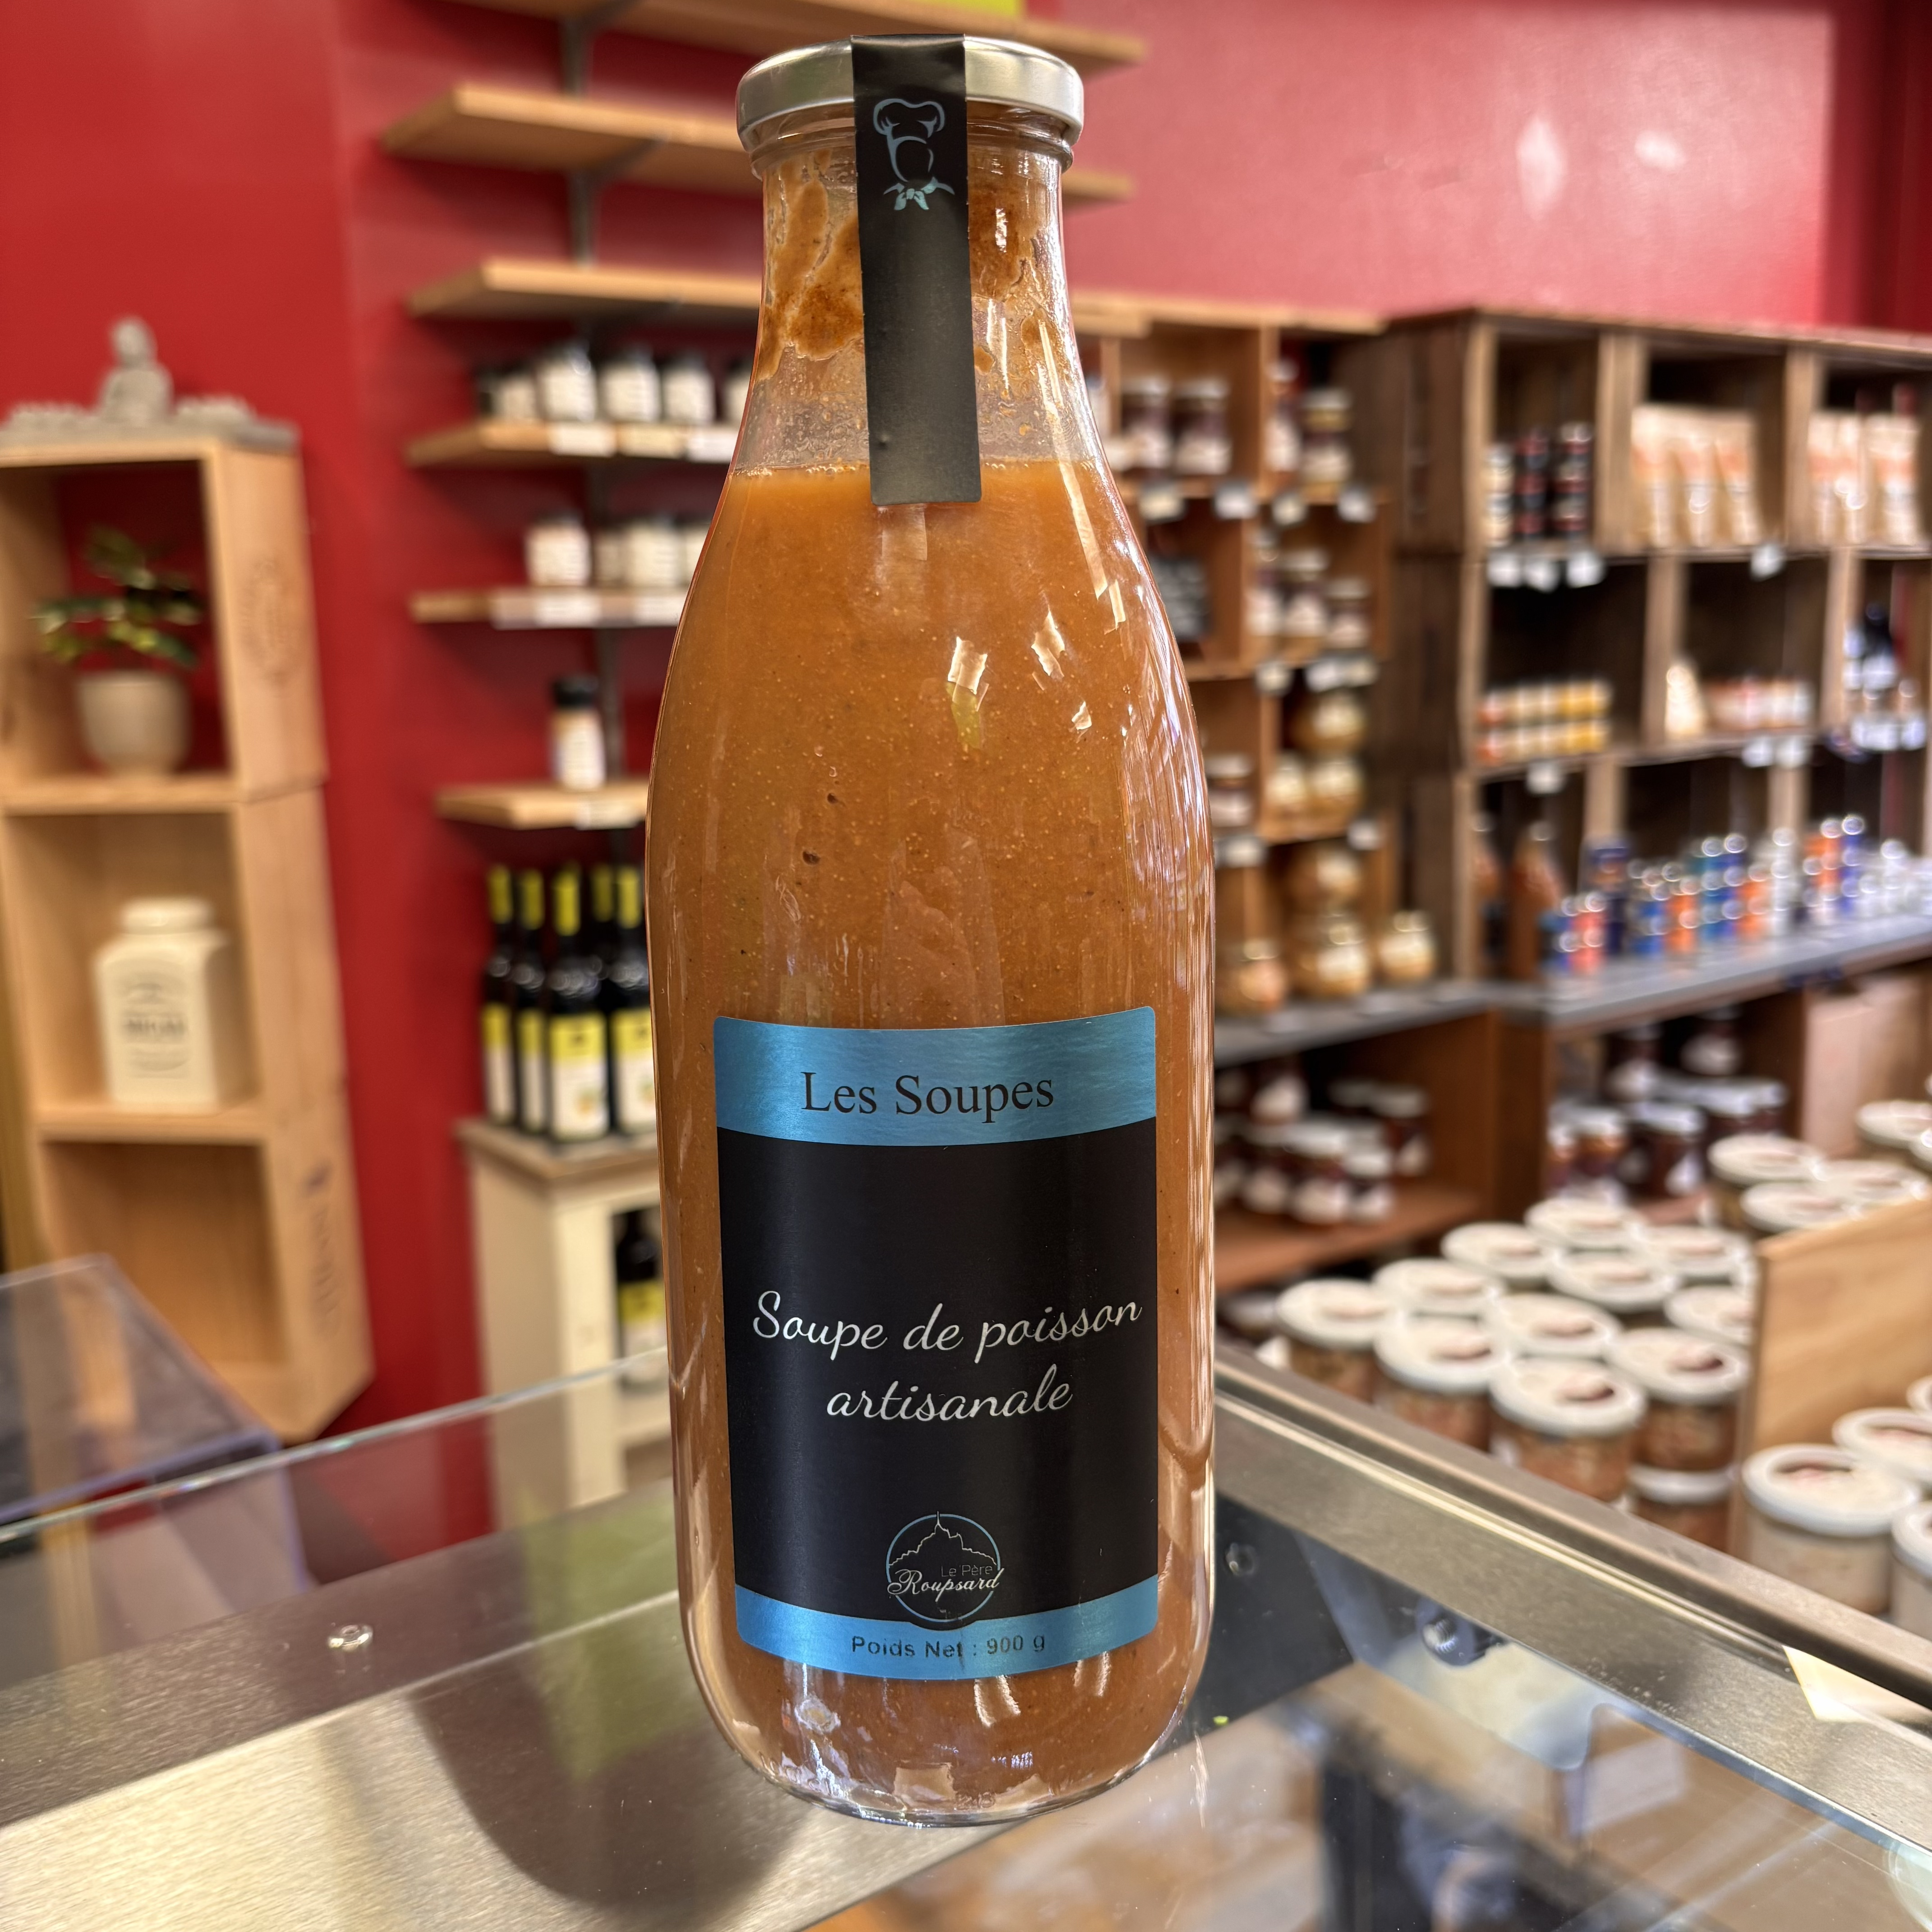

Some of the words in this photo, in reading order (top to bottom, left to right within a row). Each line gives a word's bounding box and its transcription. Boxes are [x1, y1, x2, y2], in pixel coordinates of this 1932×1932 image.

[801, 1072, 877, 1114] Les
[896, 1075, 1054, 1124] Soupes
[753, 1291, 888, 1361] Soupe
[903, 1303, 964, 1350] de
[974, 1302, 1142, 1364] poisson
[827, 1363, 1073, 1421] artisanale
[887, 1568, 1005, 1602] Roupsard
[941, 1565, 957, 1577] Le
[962, 1564, 993, 1576] Père
[851, 1636, 915, 1658] Poids
[925, 1640, 963, 1658] Net
[987, 1635, 1024, 1655] 900
[1033, 1635, 1045, 1651] g
